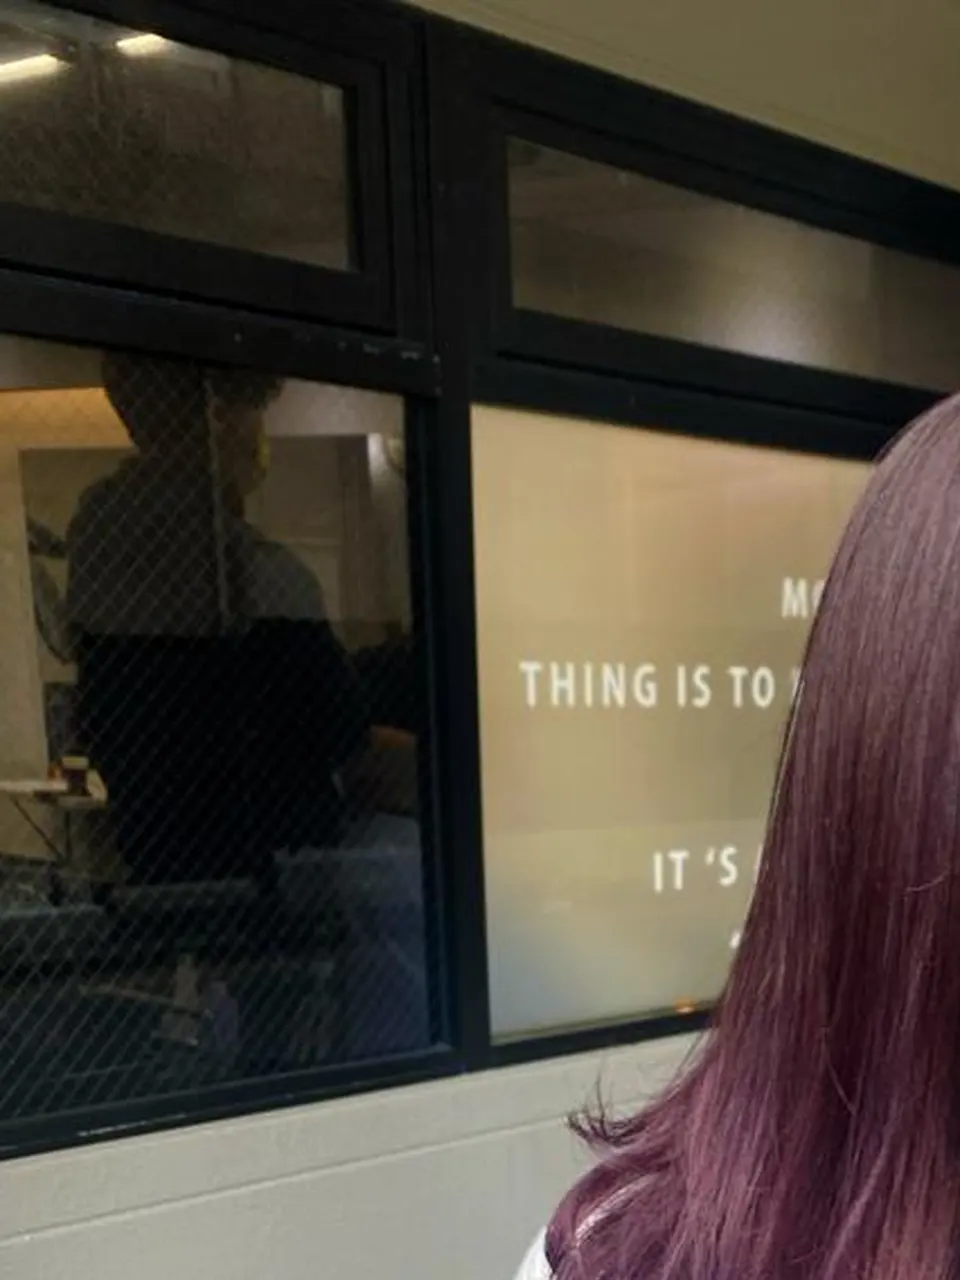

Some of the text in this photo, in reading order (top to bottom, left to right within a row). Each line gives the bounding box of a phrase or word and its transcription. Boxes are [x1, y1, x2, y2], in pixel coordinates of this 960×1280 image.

[519, 661, 659, 708] THING
[676, 664, 712, 708] IS
[727, 665, 775, 708] TO
